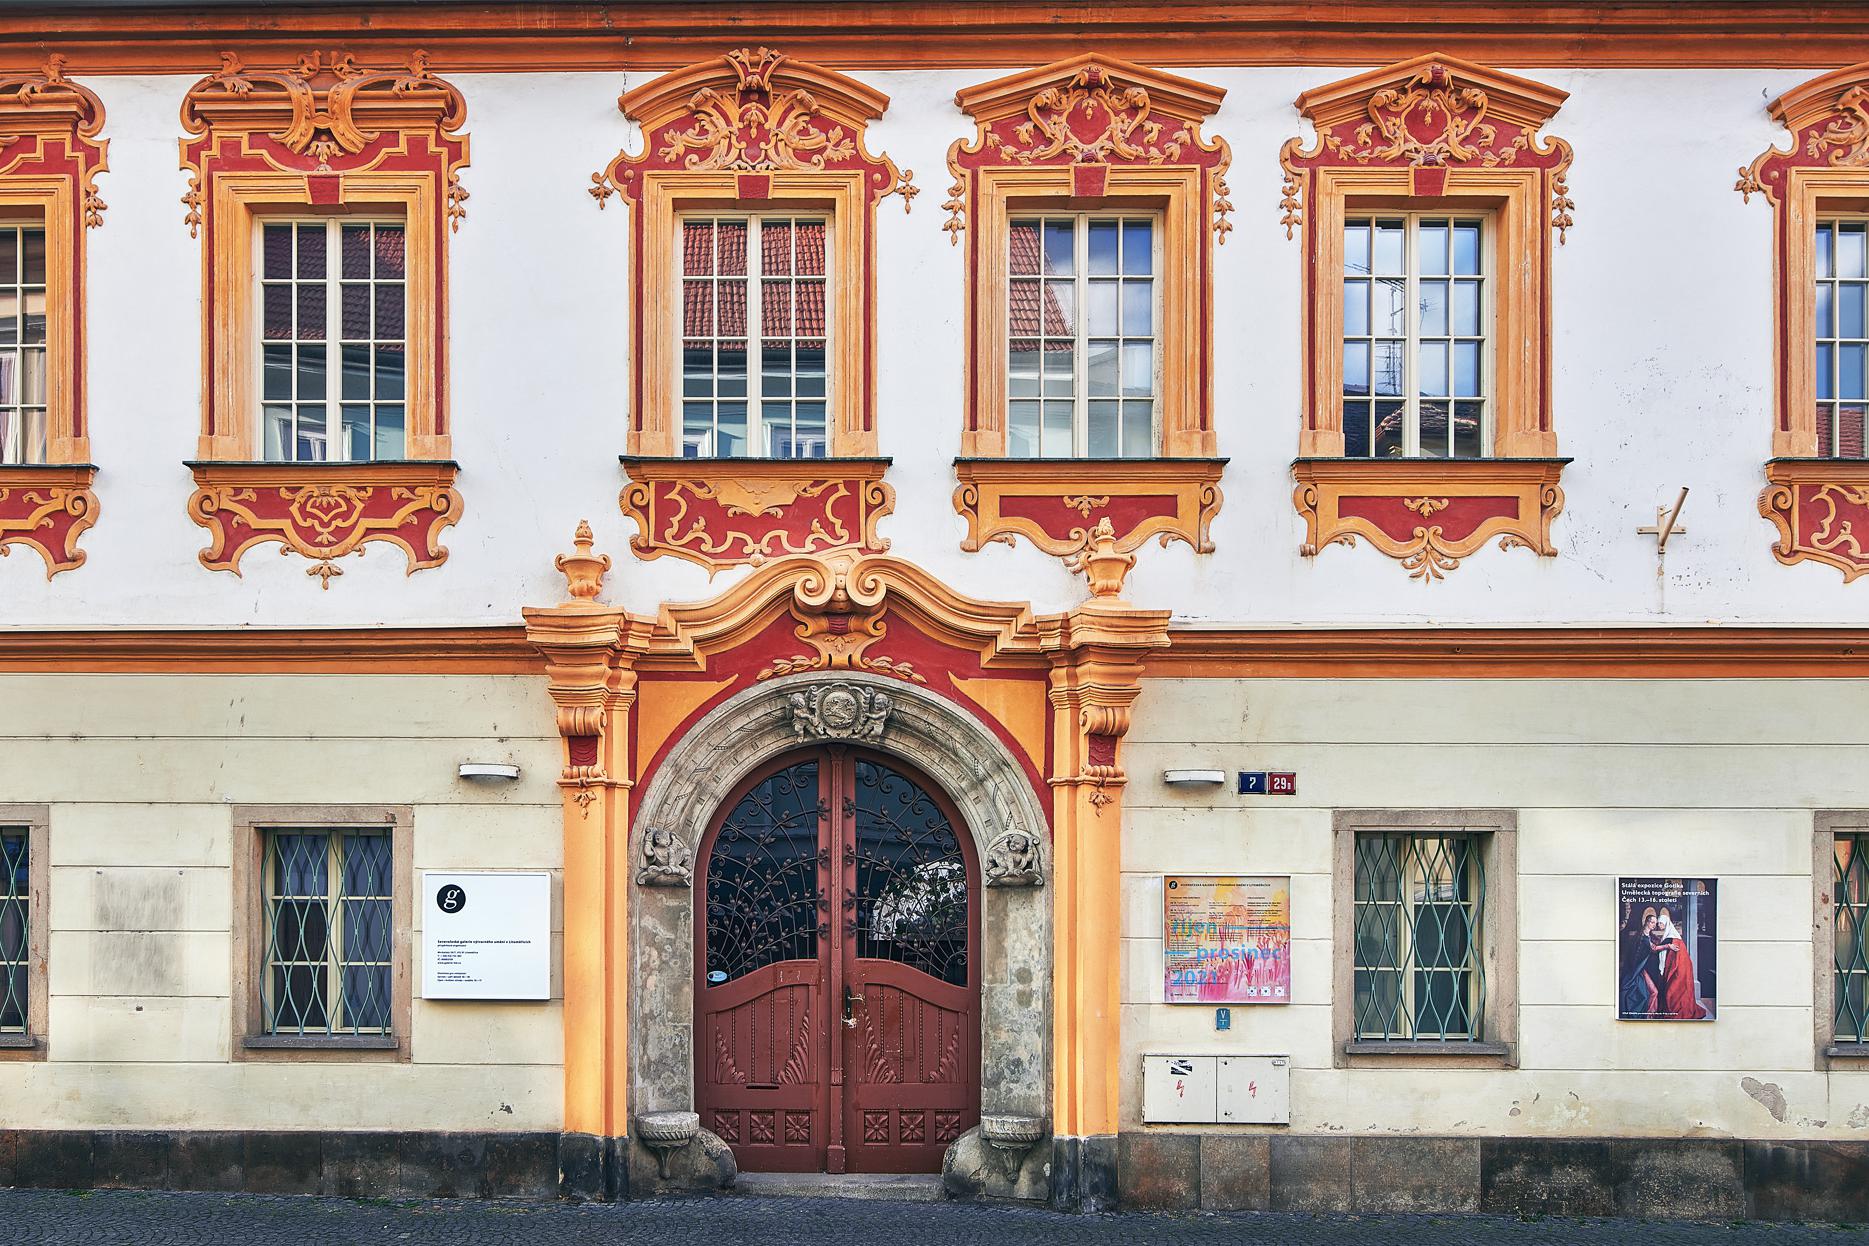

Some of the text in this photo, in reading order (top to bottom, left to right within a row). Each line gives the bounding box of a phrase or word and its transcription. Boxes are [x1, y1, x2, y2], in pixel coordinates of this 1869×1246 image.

[1250, 777, 1256, 789] 7
[444, 890, 460, 909] g
[1651, 889, 1682, 897] topografie
[1196, 944, 1281, 963] prosinec
[1172, 969, 1218, 985] 2021
